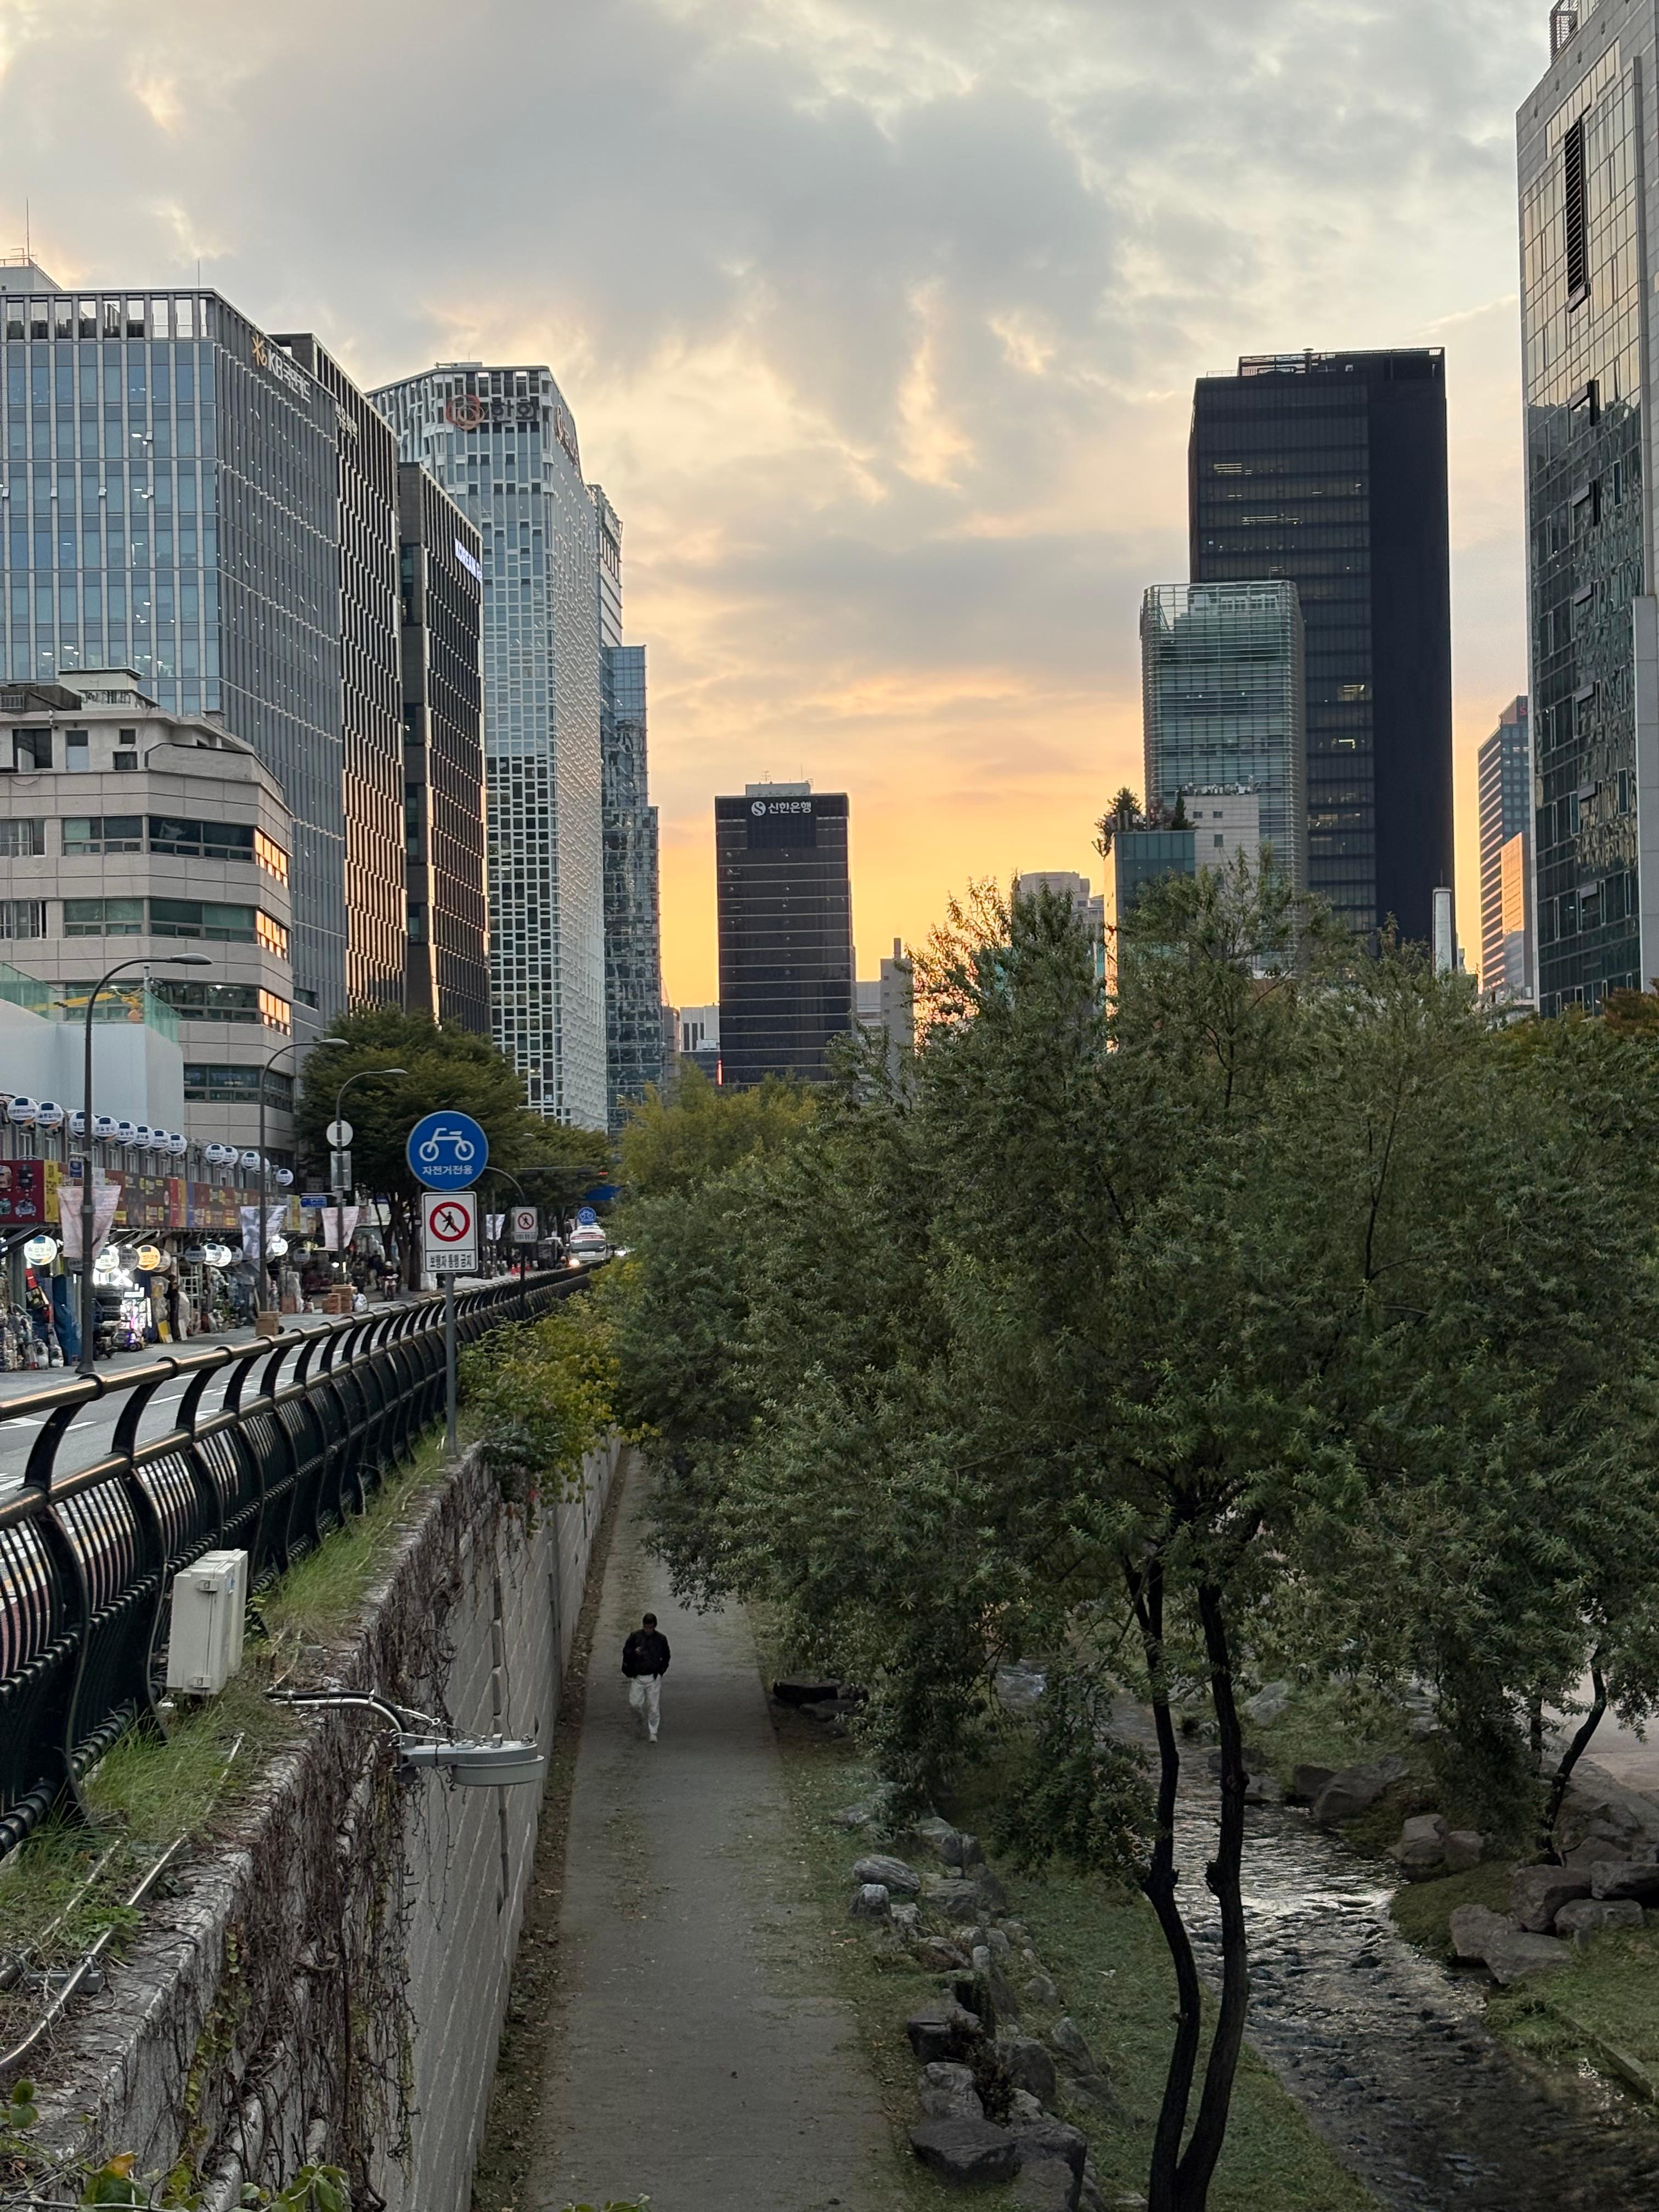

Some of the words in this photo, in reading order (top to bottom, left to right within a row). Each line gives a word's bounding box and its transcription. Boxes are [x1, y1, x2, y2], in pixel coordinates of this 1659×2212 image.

[490, 398, 539, 424] 한화
[768, 801, 811, 814] 신한은행
[422, 1165, 473, 1175] 자전거전용
